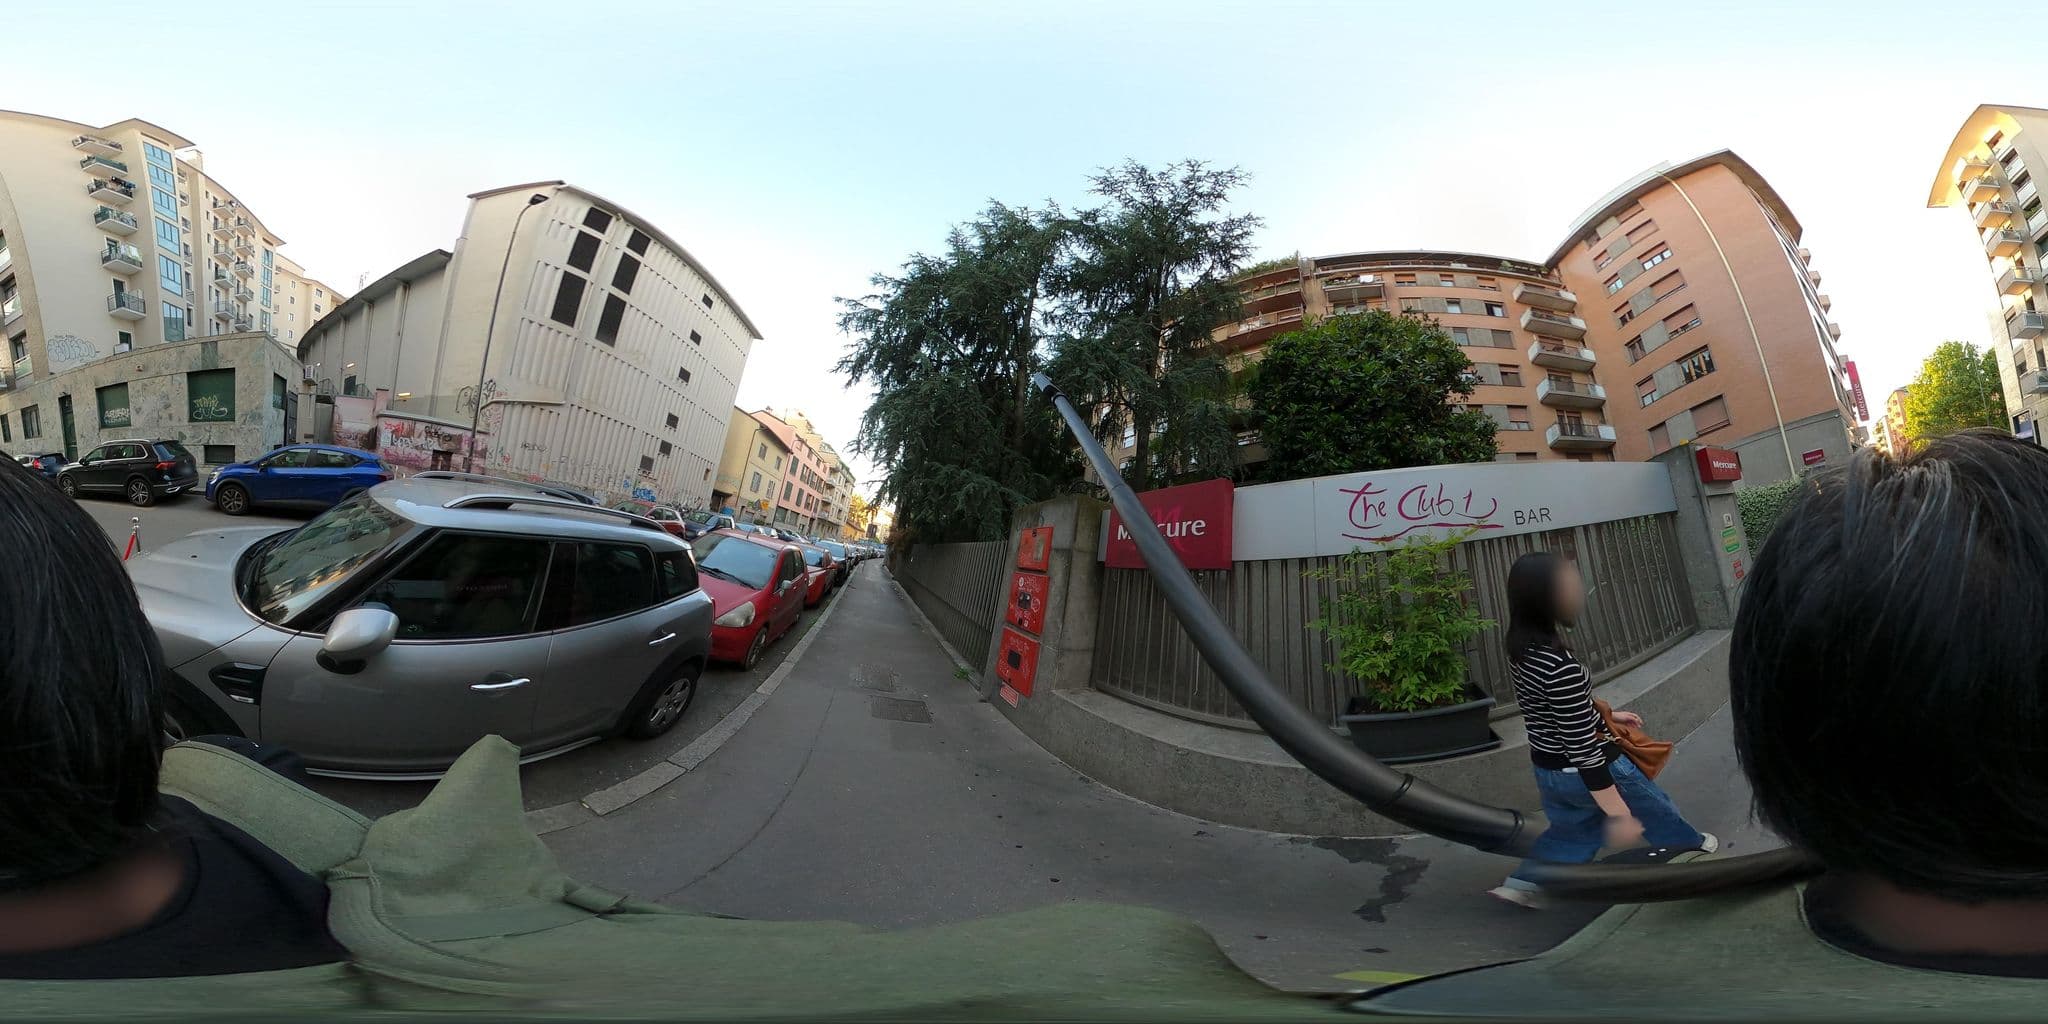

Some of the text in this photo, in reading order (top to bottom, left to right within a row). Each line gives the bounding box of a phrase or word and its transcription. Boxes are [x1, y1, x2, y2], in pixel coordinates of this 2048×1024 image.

[1339, 482, 1388, 529] The
[1397, 482, 1454, 521] Club
[1514, 507, 1552, 526] BAR
